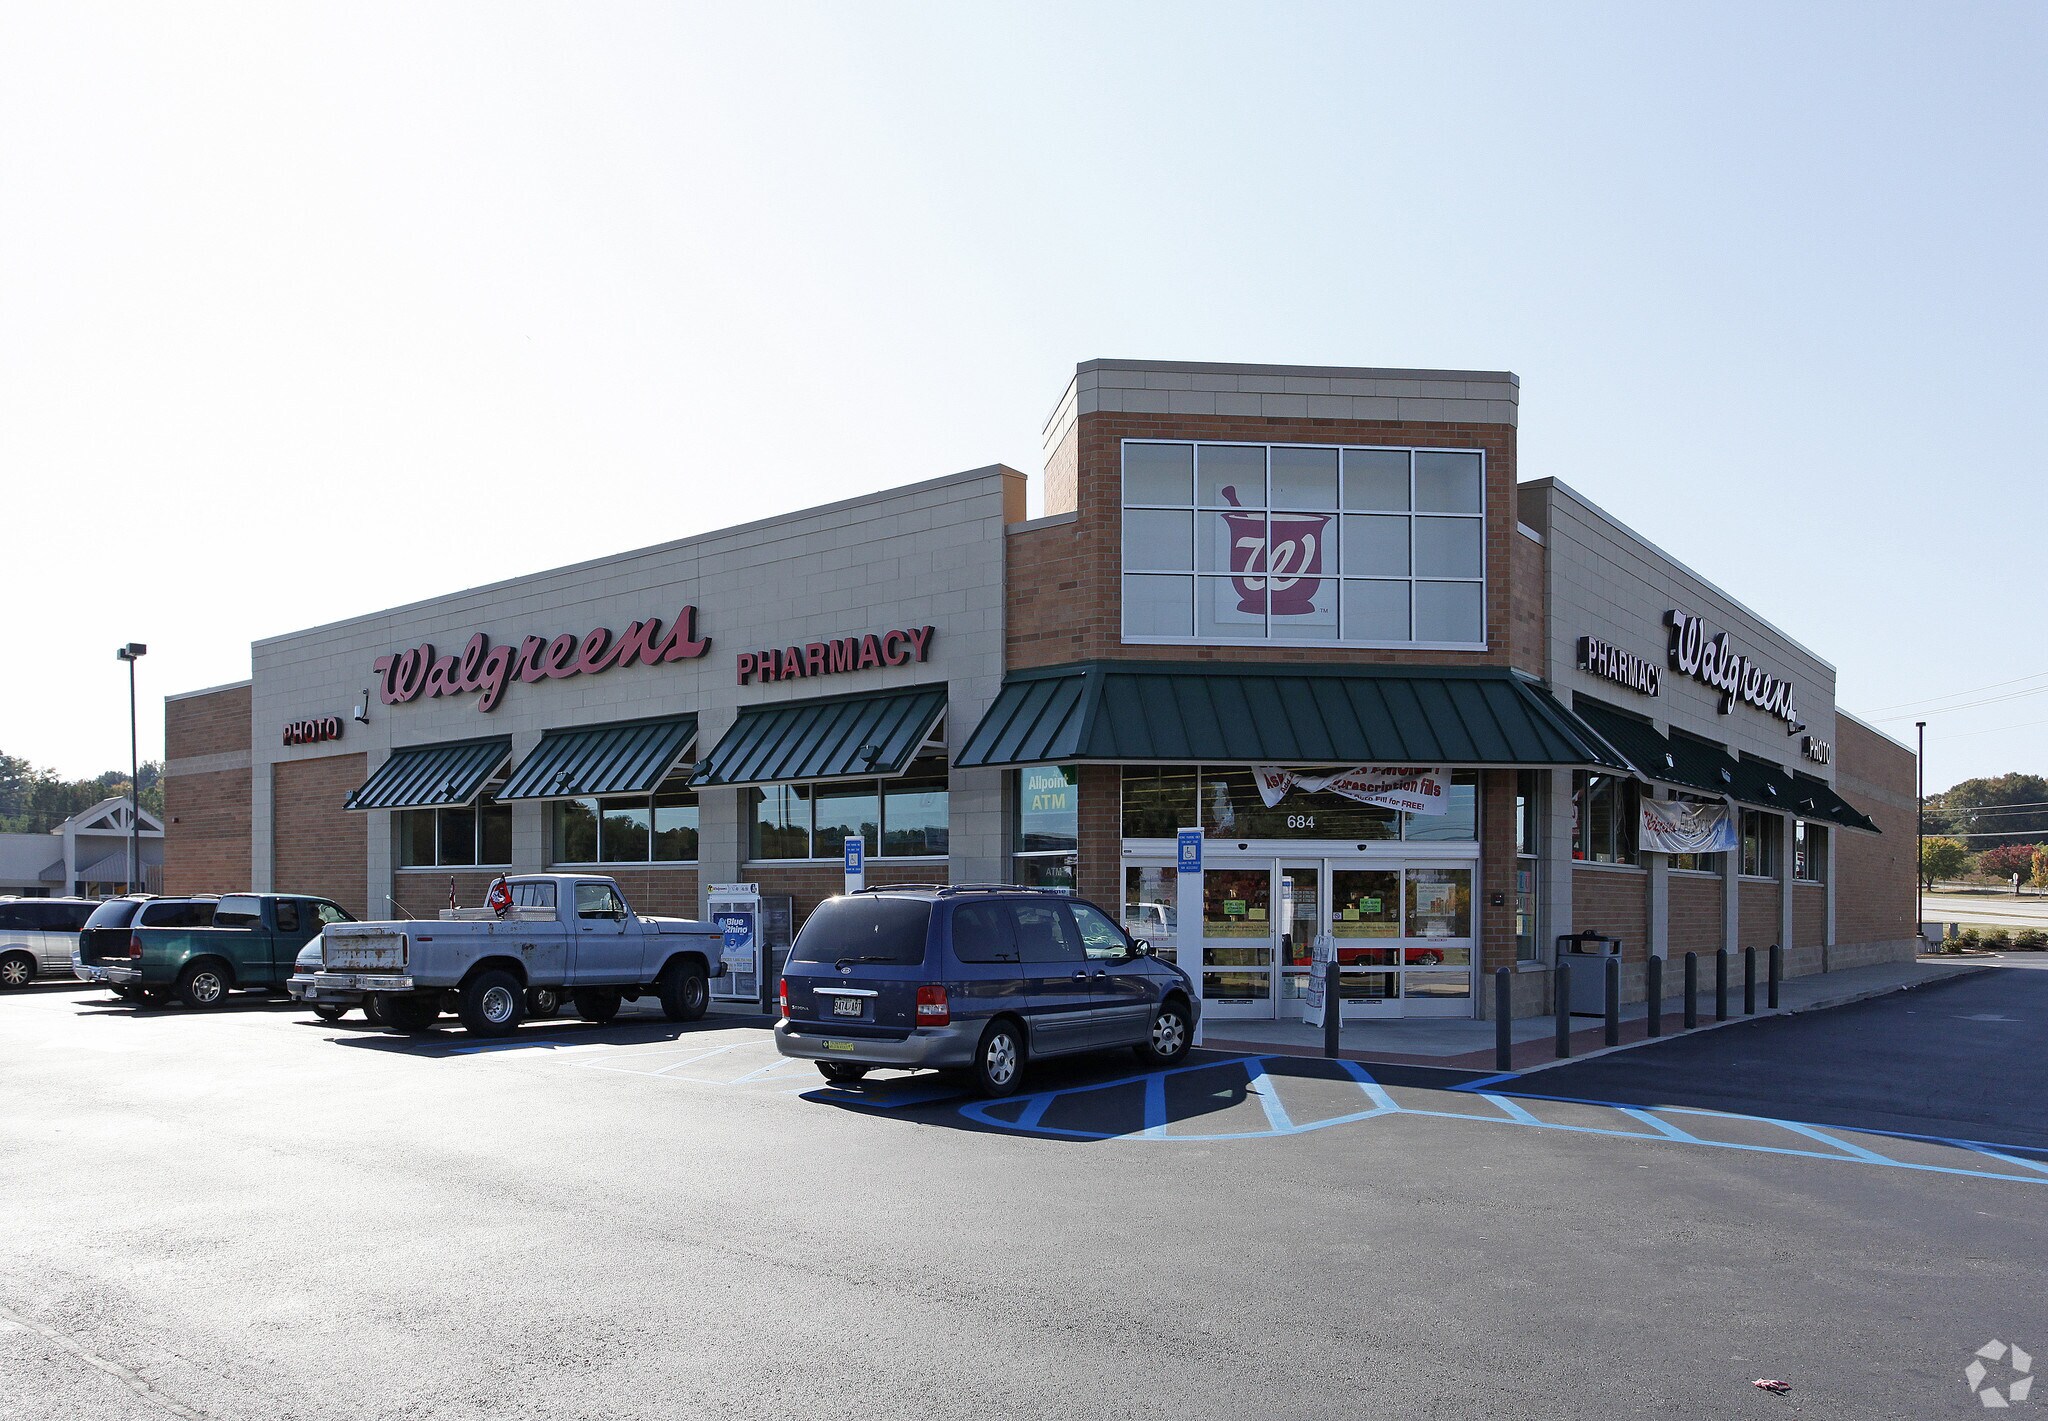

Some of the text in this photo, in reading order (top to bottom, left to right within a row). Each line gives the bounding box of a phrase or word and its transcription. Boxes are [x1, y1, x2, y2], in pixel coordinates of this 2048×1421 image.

[372, 604, 712, 713] Walgreens
[737, 625, 935, 686] PHARMACY
[1669, 609, 1798, 721] Walgreens
[1584, 636, 1664, 698] PHARMACY
[283, 716, 343, 747] PHOTO
[1806, 736, 1831, 765] PHOTO
[1028, 773, 1068, 792] Allpoint
[1420, 777, 1441, 797] fills
[1031, 793, 1066, 811] ATM
[1375, 796, 1388, 804] Fill
[1389, 797, 1400, 806] for
[1402, 799, 1425, 810] FREE!
[1286, 815, 1315, 829] 684
[1045, 867, 1062, 876] ATM
[725, 925, 747, 933] Rhino
